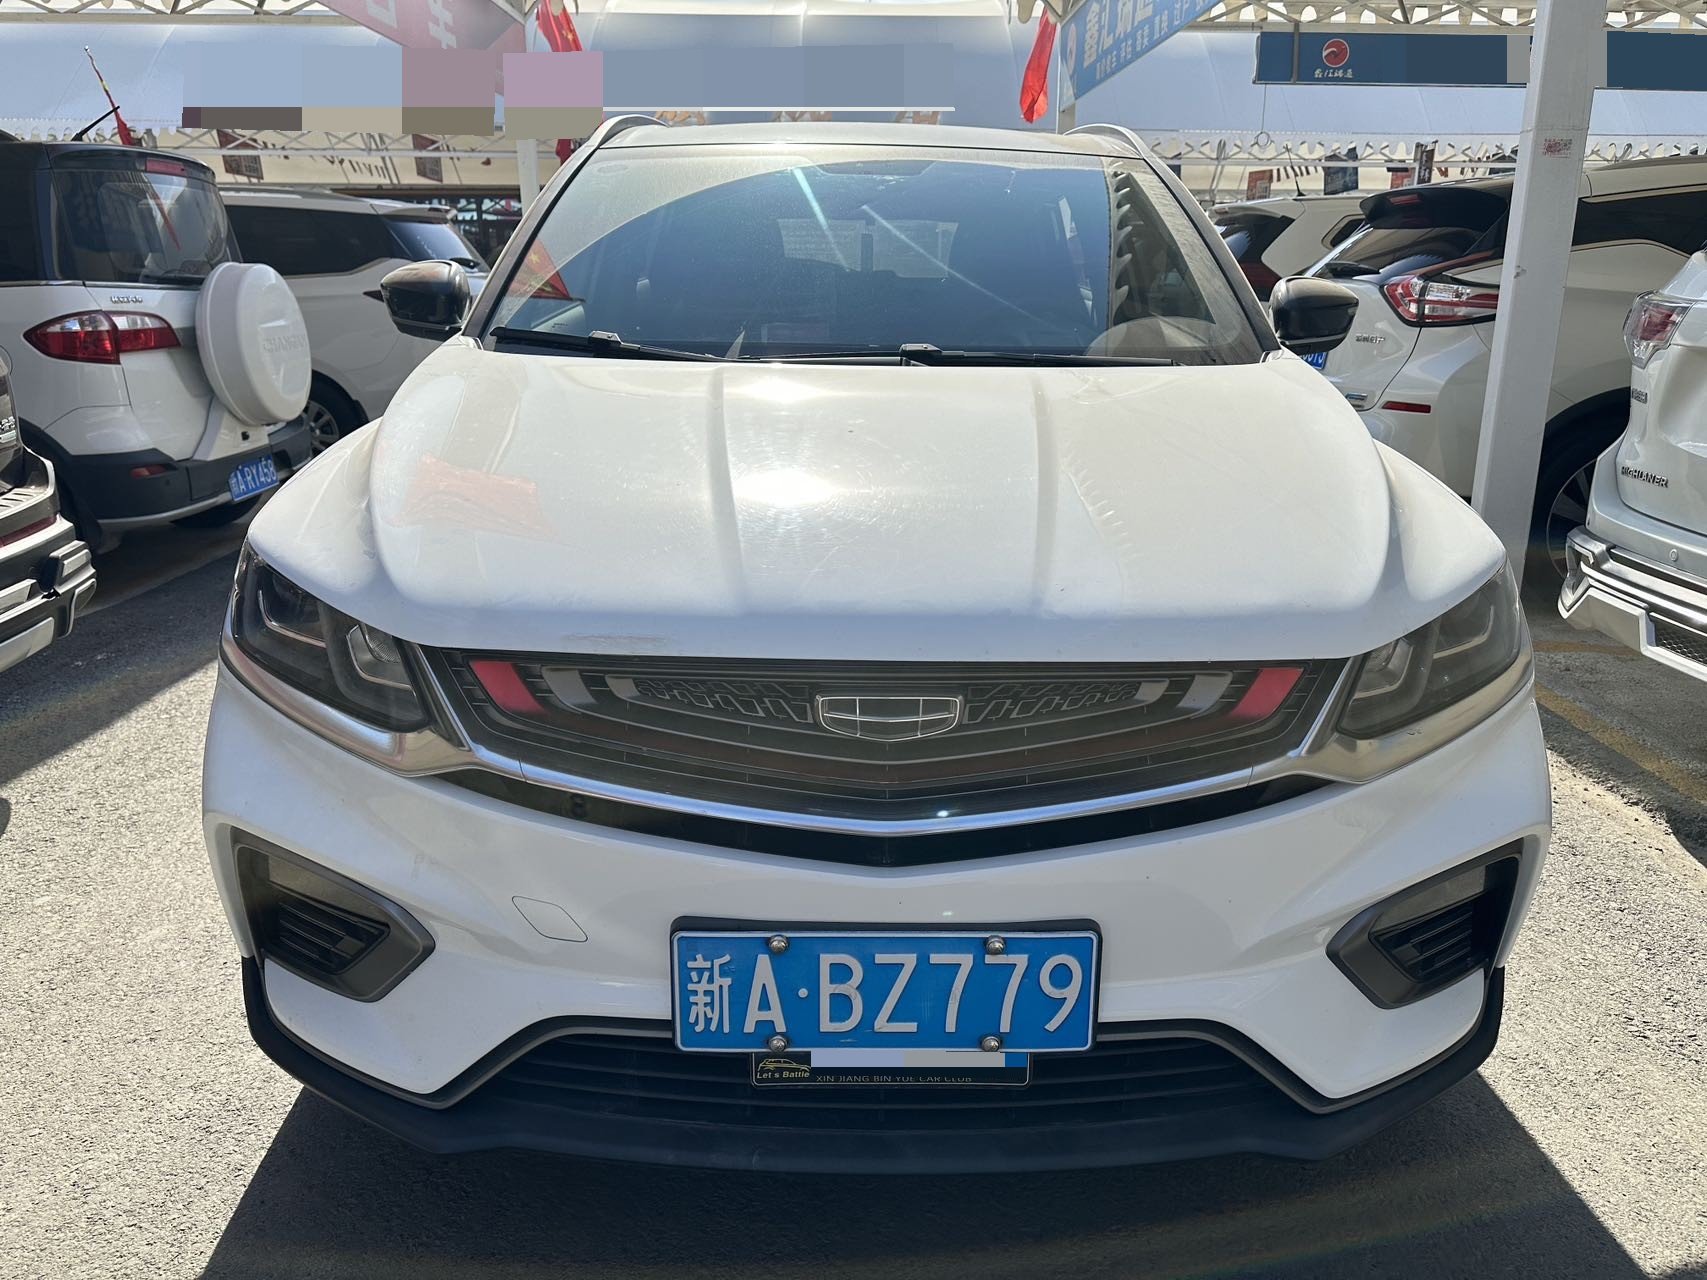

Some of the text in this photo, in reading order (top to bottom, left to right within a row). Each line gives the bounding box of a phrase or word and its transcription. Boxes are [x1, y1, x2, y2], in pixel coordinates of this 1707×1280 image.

[687, 953, 1083, 1034] 新A·BZ779
[757, 1070, 810, 1079] Lets Battle
[816, 1075, 835, 1083] XIN
[839, 1075, 870, 1083] JIANG
[873, 1075, 892, 1083] BIN
